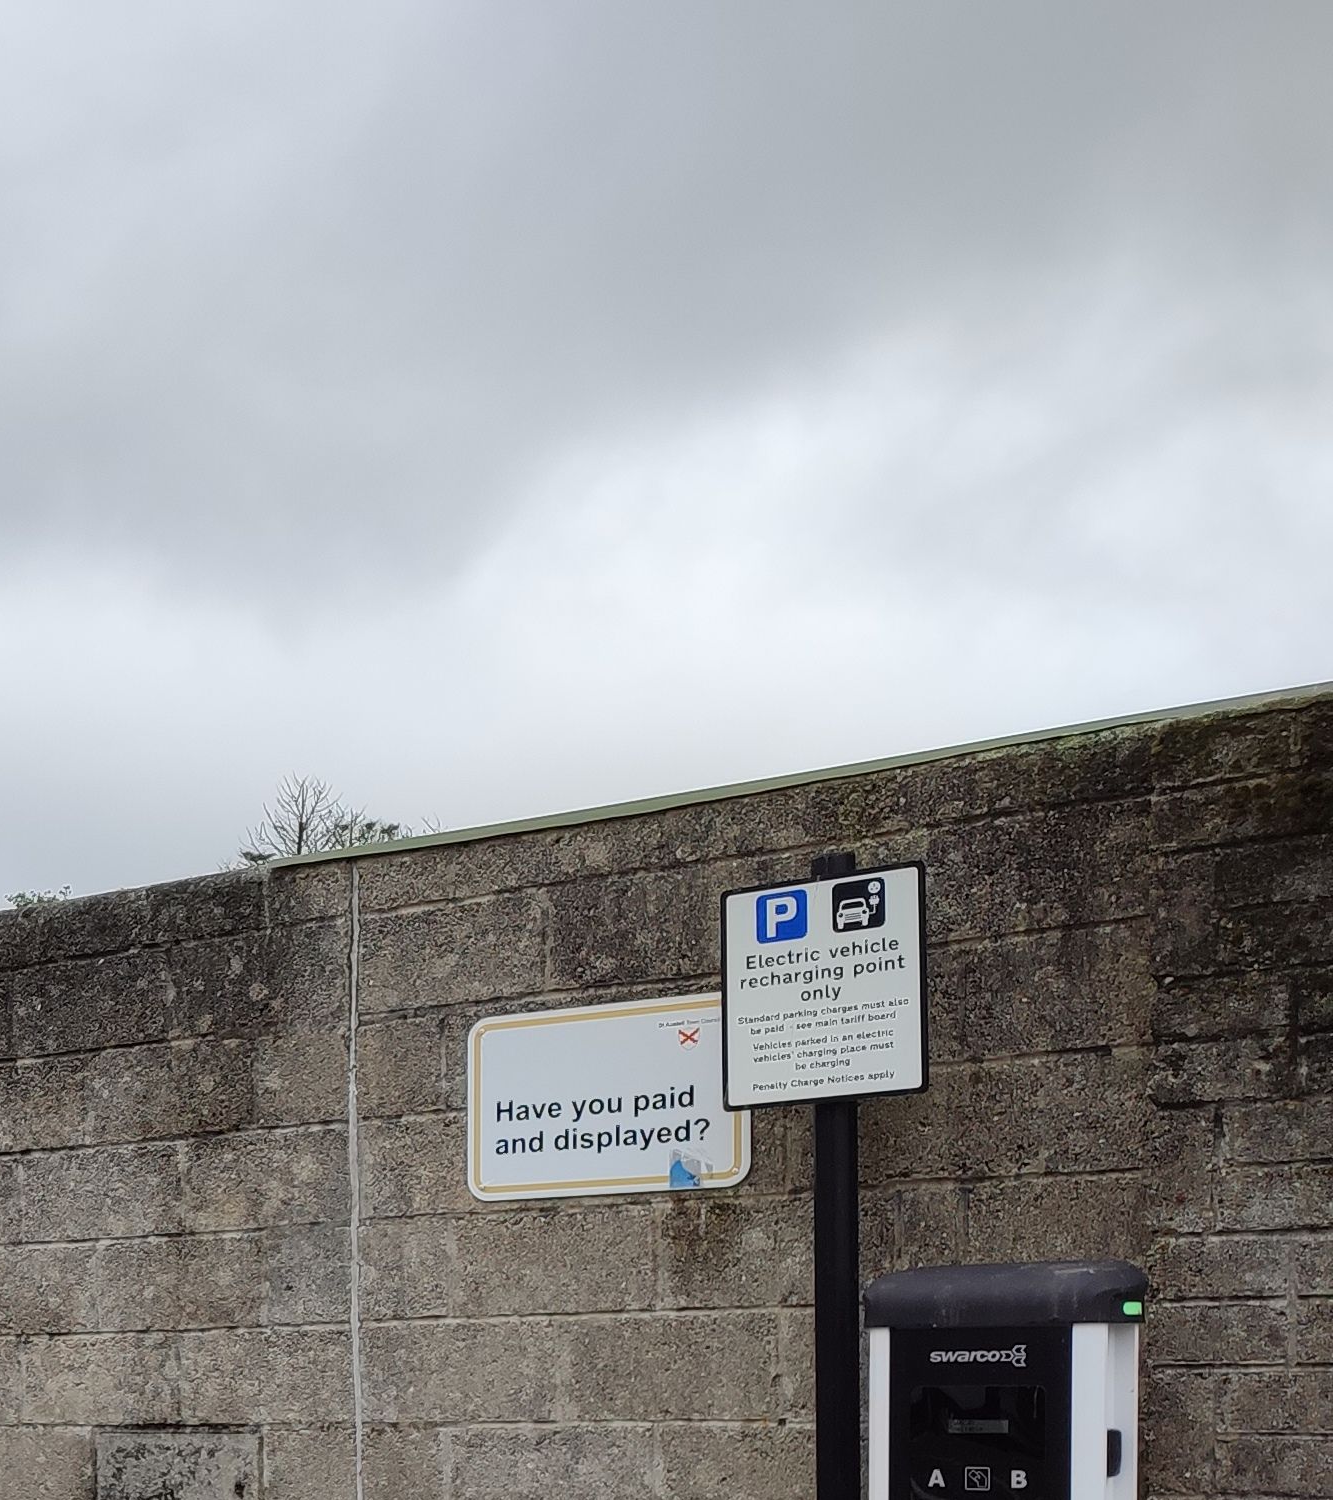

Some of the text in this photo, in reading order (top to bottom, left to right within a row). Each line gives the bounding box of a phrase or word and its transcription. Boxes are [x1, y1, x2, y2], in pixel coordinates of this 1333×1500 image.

[766, 896, 797, 939] P
[746, 938, 899, 970] Electric vehicle
[740, 955, 905, 989] recharging point
[801, 985, 841, 1001] only
[738, 998, 909, 1025] Standard parking charges must also
[751, 1027, 761, 1035] be
[765, 1024, 784, 1035] paid
[796, 1022, 812, 1030] see
[815, 1018, 837, 1027] main
[841, 1014, 865, 1025] tariff
[868, 1011, 896, 1022] board
[753, 1040, 791, 1051] Vehicles
[795, 1036, 827, 1048] parked
[842, 1033, 853, 1041] an
[857, 1029, 893, 1040] electric
[797, 1047, 837, 1059] charging
[841, 1044, 867, 1054] place
[870, 1042, 894, 1050] must
[795, 1058, 851, 1070] be charging
[753, 1069, 895, 1092] Penalty Charge Notices apply
[496, 1084, 695, 1122] Have you paid
[495, 1118, 711, 1155] and displayed?
[929, 1350, 1000, 1362] swarco
[928, 1469, 1027, 1488] A B
